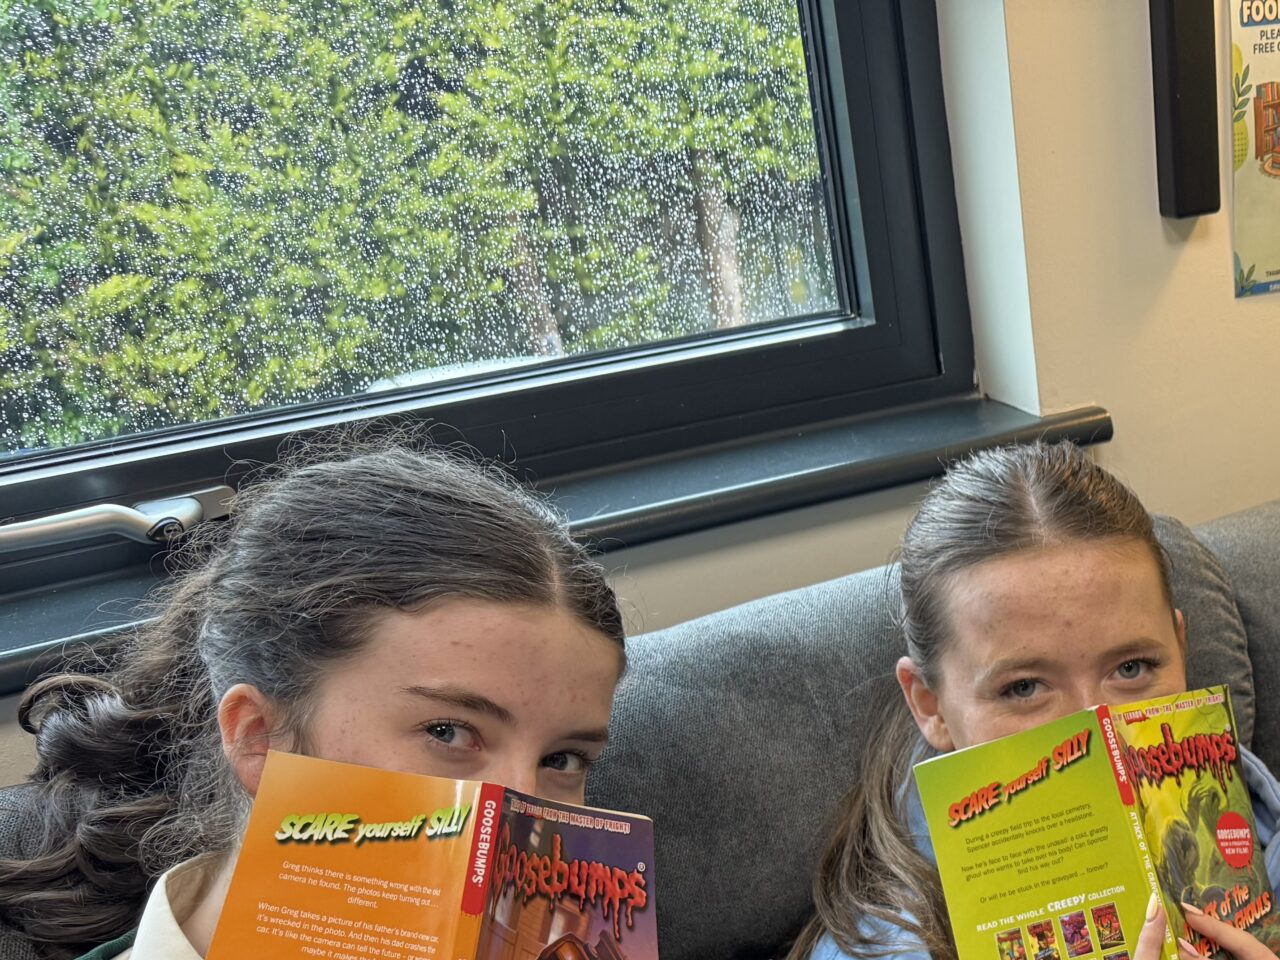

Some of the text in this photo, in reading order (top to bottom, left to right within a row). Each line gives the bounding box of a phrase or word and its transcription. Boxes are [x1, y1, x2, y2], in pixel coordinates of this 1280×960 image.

[1253, 42, 1276, 54] FREE
[1144, 706, 1160, 717] FROM
[1162, 704, 1172, 713] THE
[1175, 700, 1194, 711] MASTER
[1196, 698, 1203, 706] OF
[1102, 717, 1128, 784] GOOSEBUMPS
[948, 728, 1090, 828] SCARE yourself SILLY
[275, 804, 472, 844] SCARE yourself SILLY
[570, 813, 594, 828] MASTER
[1216, 828, 1250, 840] GOOSEBUMPS
[471, 800, 497, 888] GOOSEBUMPS
[1129, 811, 1145, 842] ATTACK
[1138, 841, 1148, 852] OF
[1143, 854, 1152, 868] THE
[278, 872, 421, 906] camera he found. The photos keep turning
[282, 860, 300, 872] Greg
[301, 864, 324, 876] thinks
[324, 869, 344, 879] there
[352, 875, 389, 888] something
[390, 882, 408, 892] wrong
[409, 884, 422, 893] with
[422, 886, 432, 894] the
[432, 888, 441, 896] old
[347, 896, 378, 909] different.
[976, 885, 1126, 932] READ THE WHOLE CREEPY COLLECTION
[1220, 884, 1250, 916] of the
[1234, 892, 1272, 930] GHOULS
